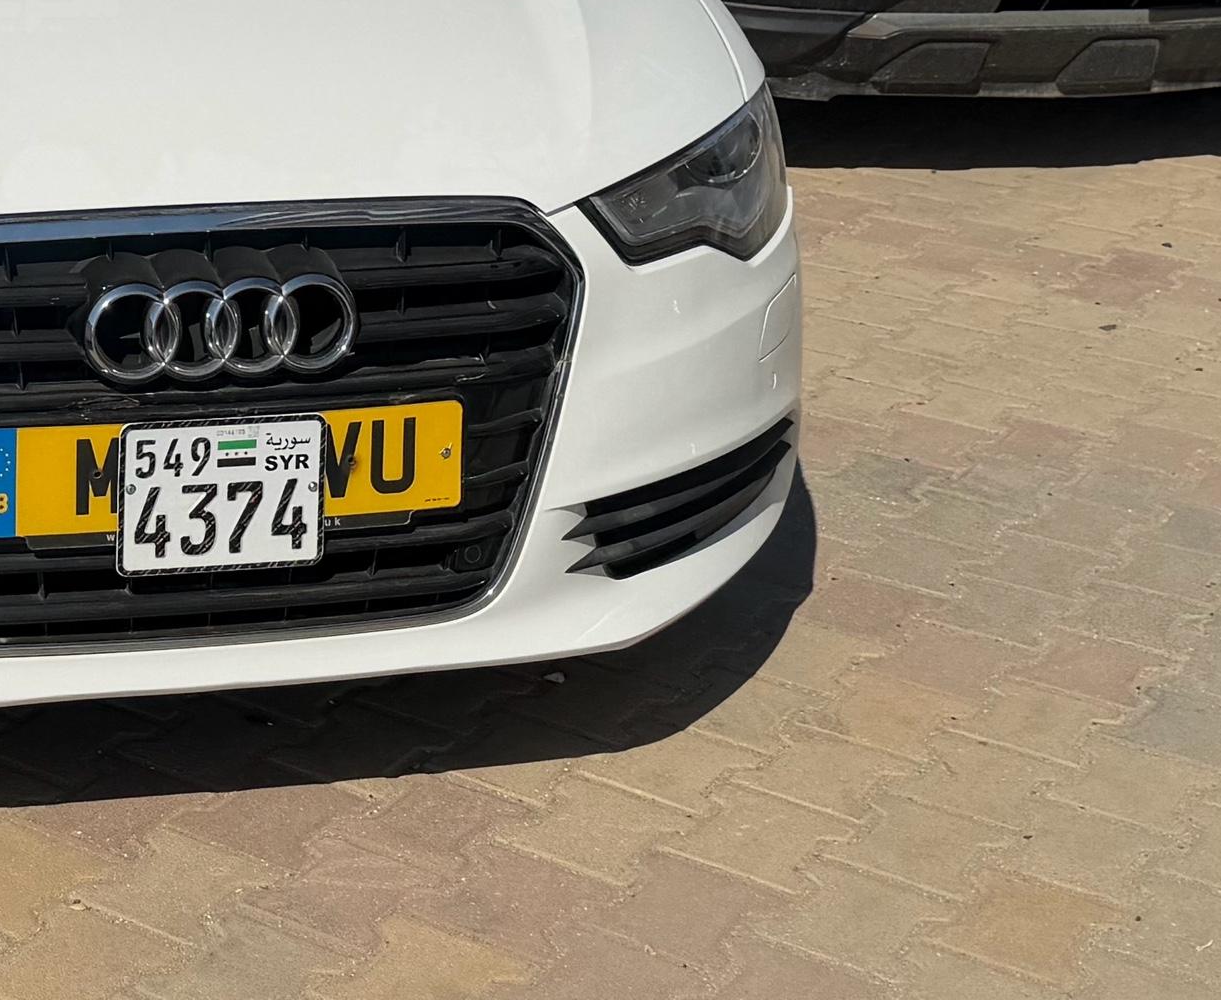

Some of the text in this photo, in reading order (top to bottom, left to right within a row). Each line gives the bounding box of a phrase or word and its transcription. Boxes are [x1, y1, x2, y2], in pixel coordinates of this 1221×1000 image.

[135, 437, 212, 479] 549
[265, 432, 311, 451] سورية
[325, 417, 417, 498] VU
[264, 454, 310, 472] SYR
[134, 478, 309, 557] 4374
